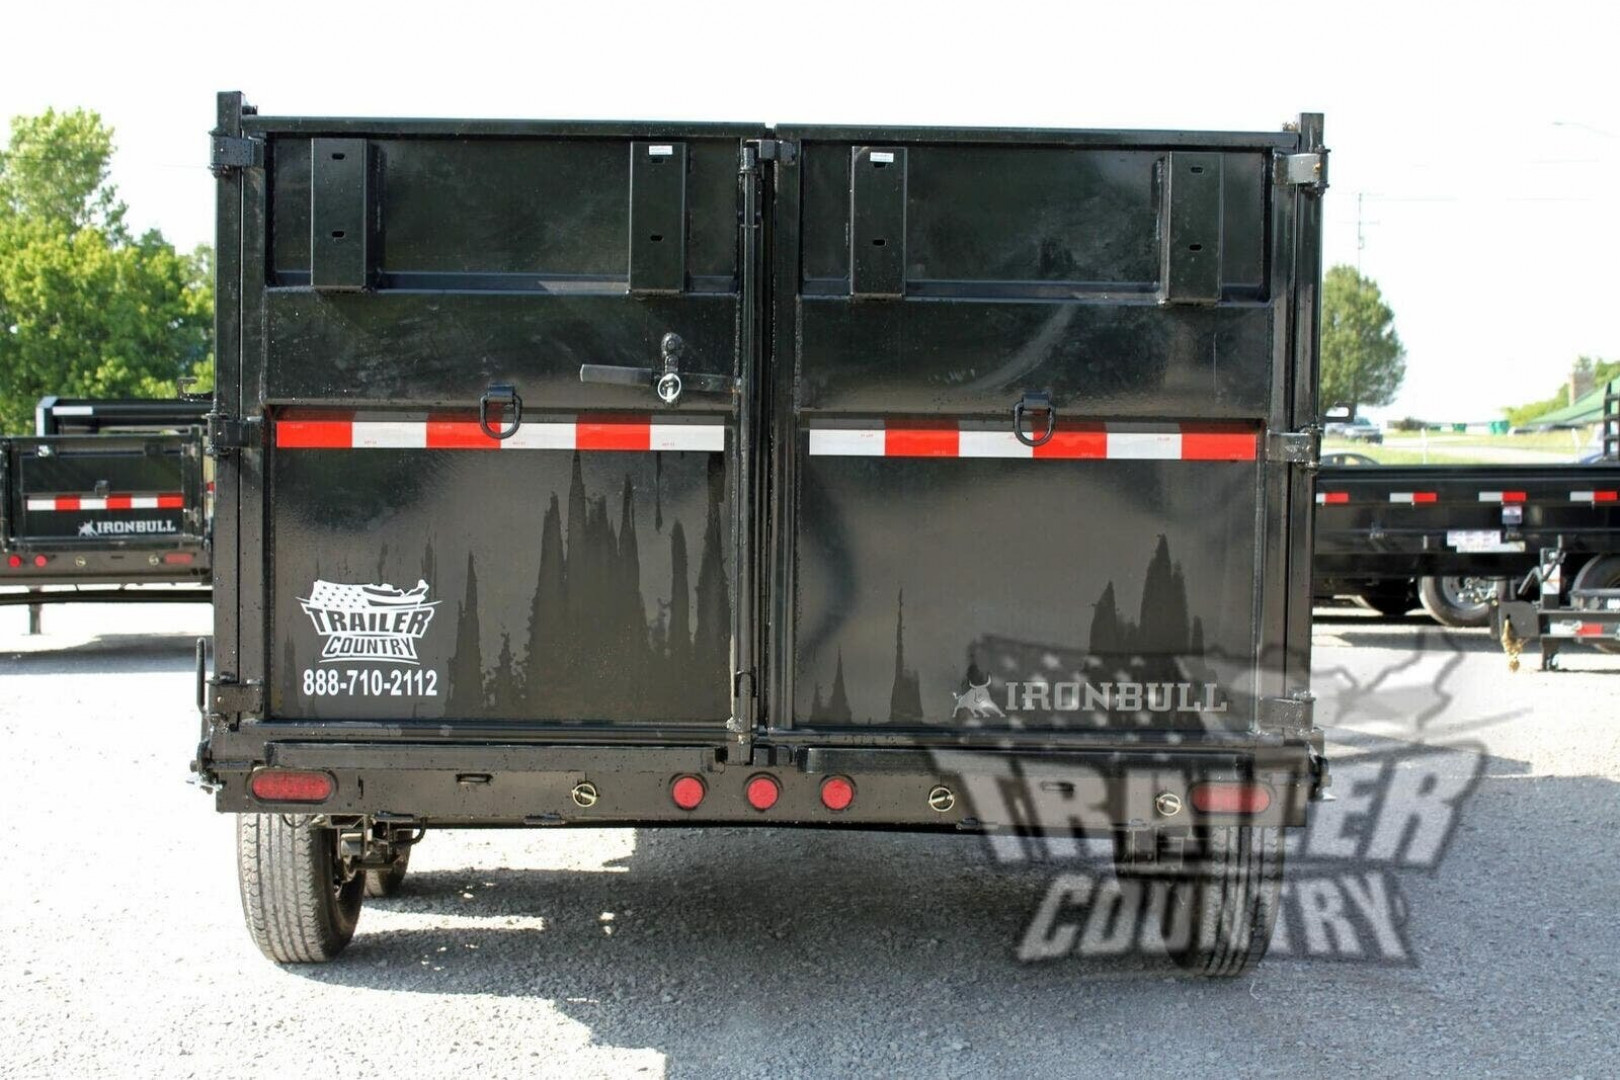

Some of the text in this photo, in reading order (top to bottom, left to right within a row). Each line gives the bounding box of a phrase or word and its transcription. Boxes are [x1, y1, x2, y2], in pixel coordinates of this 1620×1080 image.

[97, 520, 176, 534] IRONBULL
[304, 606, 432, 635] TRAILER
[323, 635, 414, 657] COUNTRY
[303, 668, 438, 696] 888-710-2112
[1005, 681, 1228, 713] IRONBULL
